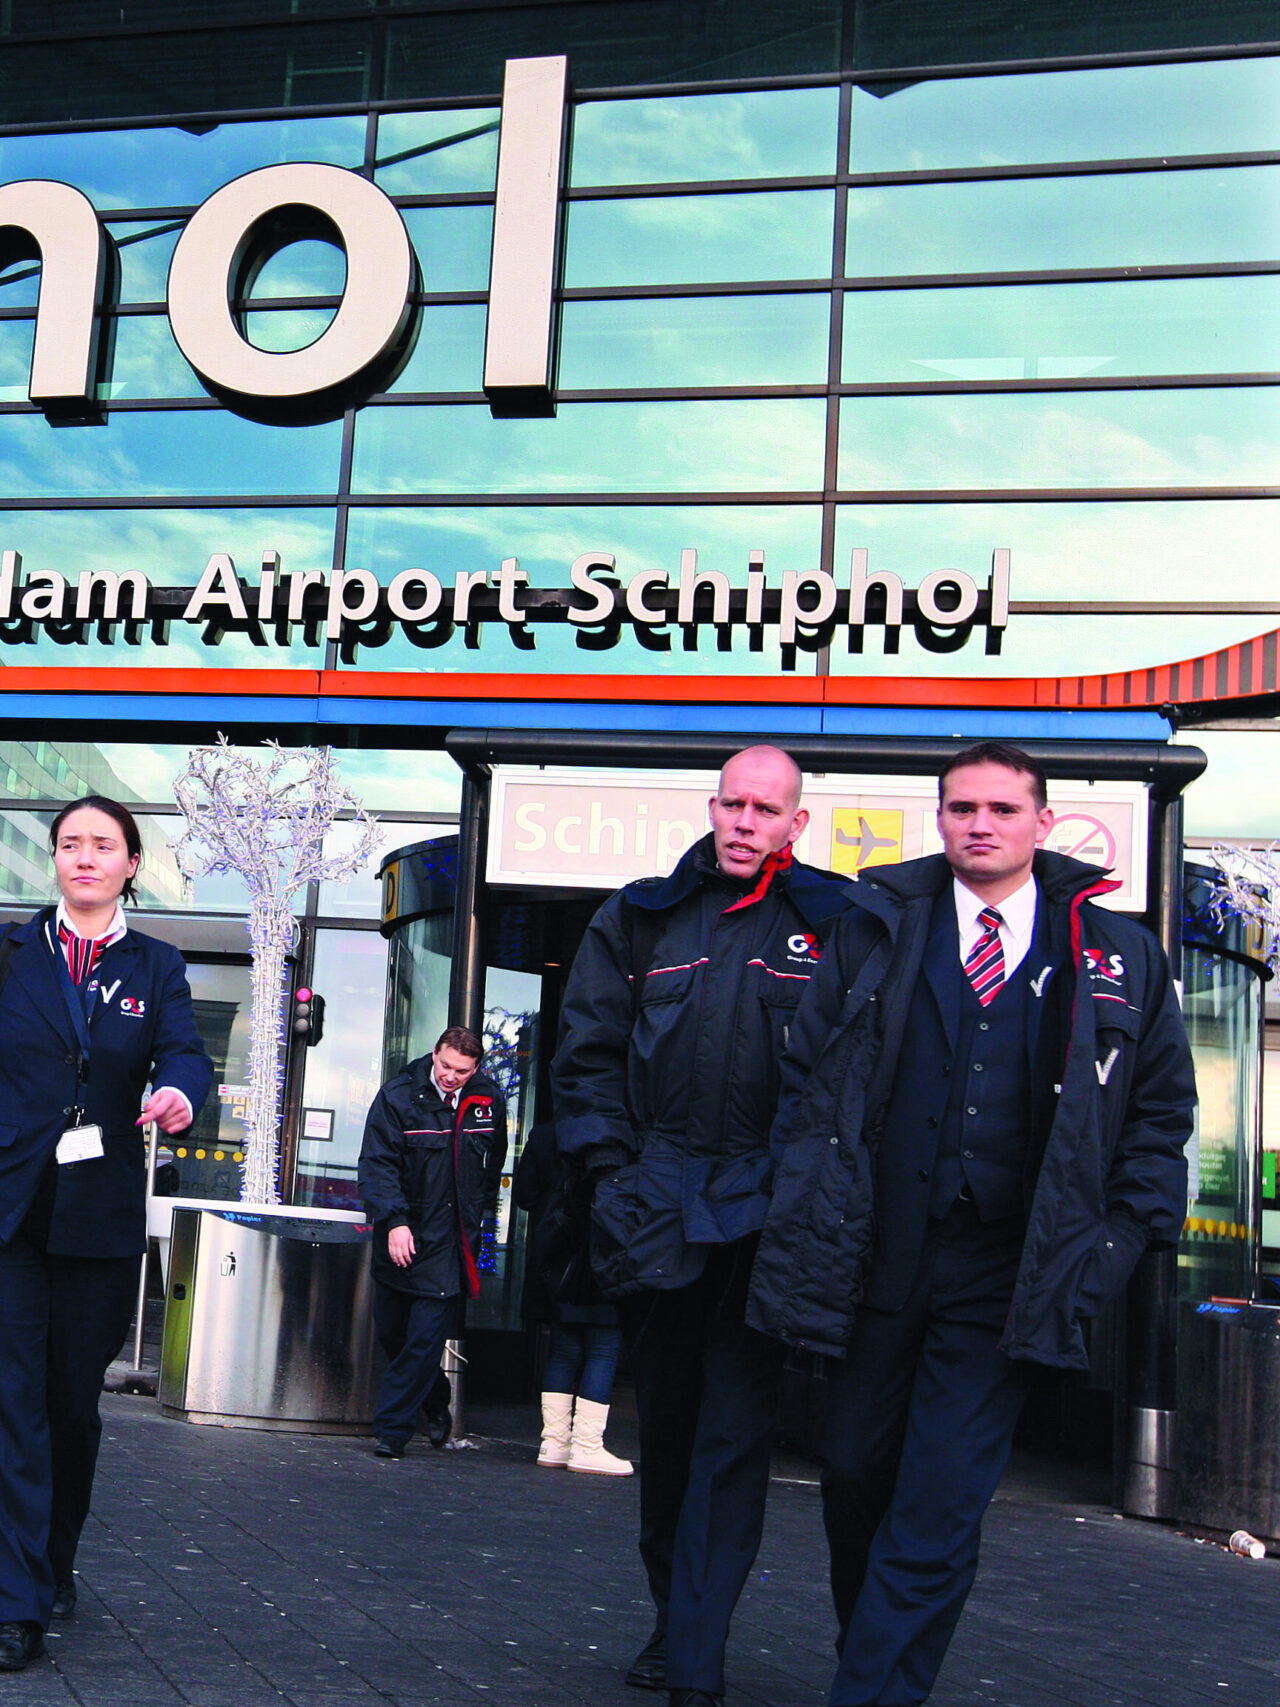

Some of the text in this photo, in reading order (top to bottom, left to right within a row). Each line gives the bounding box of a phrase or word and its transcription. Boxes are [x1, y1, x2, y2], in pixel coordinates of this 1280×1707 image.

[183, 550, 528, 640] Airport
[567, 548, 1011, 648] Schiphol
[514, 801, 812, 872] Schipl
[236, 1212, 263, 1224] Papier
